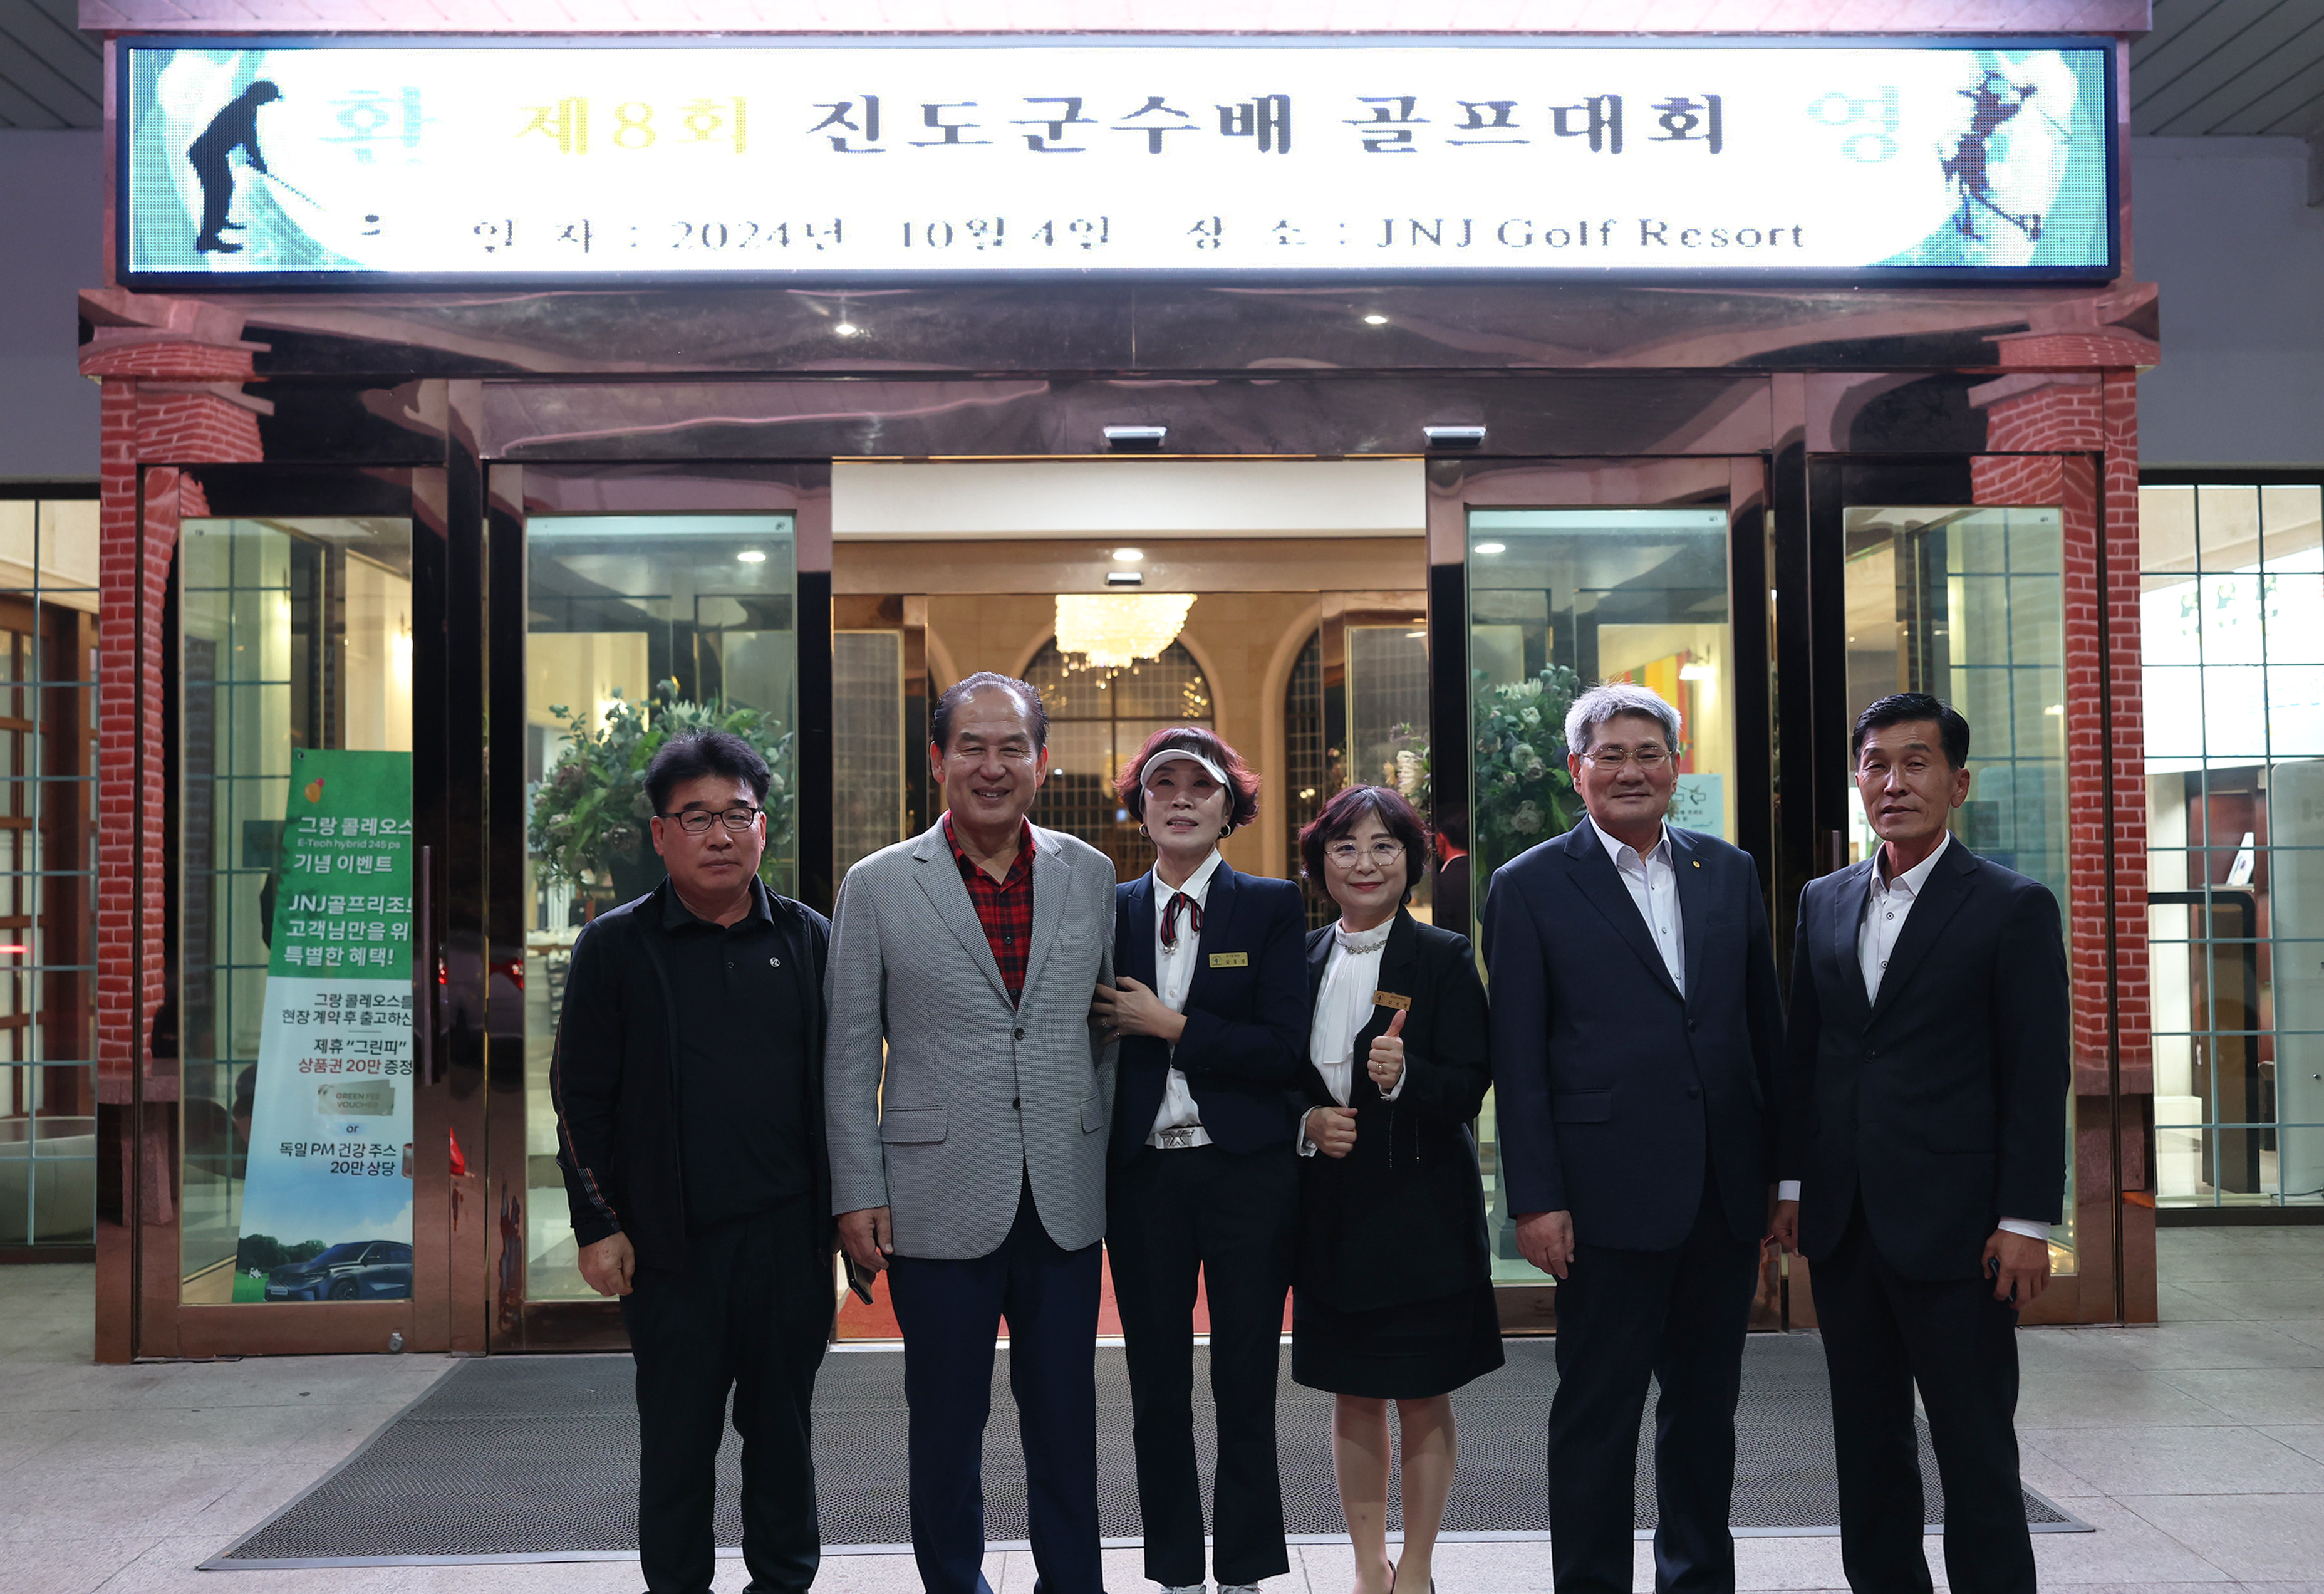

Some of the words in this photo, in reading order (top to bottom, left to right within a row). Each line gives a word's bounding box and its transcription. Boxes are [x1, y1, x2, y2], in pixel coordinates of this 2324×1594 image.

[515, 95, 747, 156] 제8회
[806, 93, 1294, 155] 진도군수배
[1341, 93, 1724, 155] 골프대회
[1807, 85, 1900, 164] 영
[671, 218, 843, 250] 2024년
[903, 217, 1004, 250] 10월
[1032, 216, 1108, 250] 4일
[1377, 218, 1473, 248] JNJ
[1497, 218, 1617, 248] Golf
[1639, 218, 1803, 248] Resort
[298, 816, 337, 836] 그랑
[341, 818, 412, 836] 콜레오스
[298, 838, 332, 848] E-Tech
[334, 839, 366, 850] hybrid
[368, 840, 386, 849] 245
[294, 853, 331, 874] 기념
[336, 855, 393, 875] 이벤트
[289, 894, 412, 915] JNJ골프리조
[286, 920, 386, 942] 고객님만을
[284, 945, 345, 967] 특별한
[348, 947, 395, 967] 혜택!
[314, 993, 343, 1009] 그랑
[345, 994, 412, 1010] 콜레오스를
[282, 1009, 311, 1025] 현장
[313, 1010, 341, 1025] 계약
[343, 1011, 356, 1025] 후
[314, 1038, 344, 1055] 제휴
[298, 1058, 343, 1075] 상품권
[345, 1059, 382, 1075] 20만
[384, 1060, 412, 1076] 증정
[346, 1125, 359, 1133] or
[279, 1142, 308, 1157] 독일
[310, 1143, 335, 1156] PM
[338, 1143, 367, 1158] 건강
[368, 1143, 397, 1159] 주스
[330, 1161, 365, 1176] 20만
[366, 1162, 396, 1177] 상당
